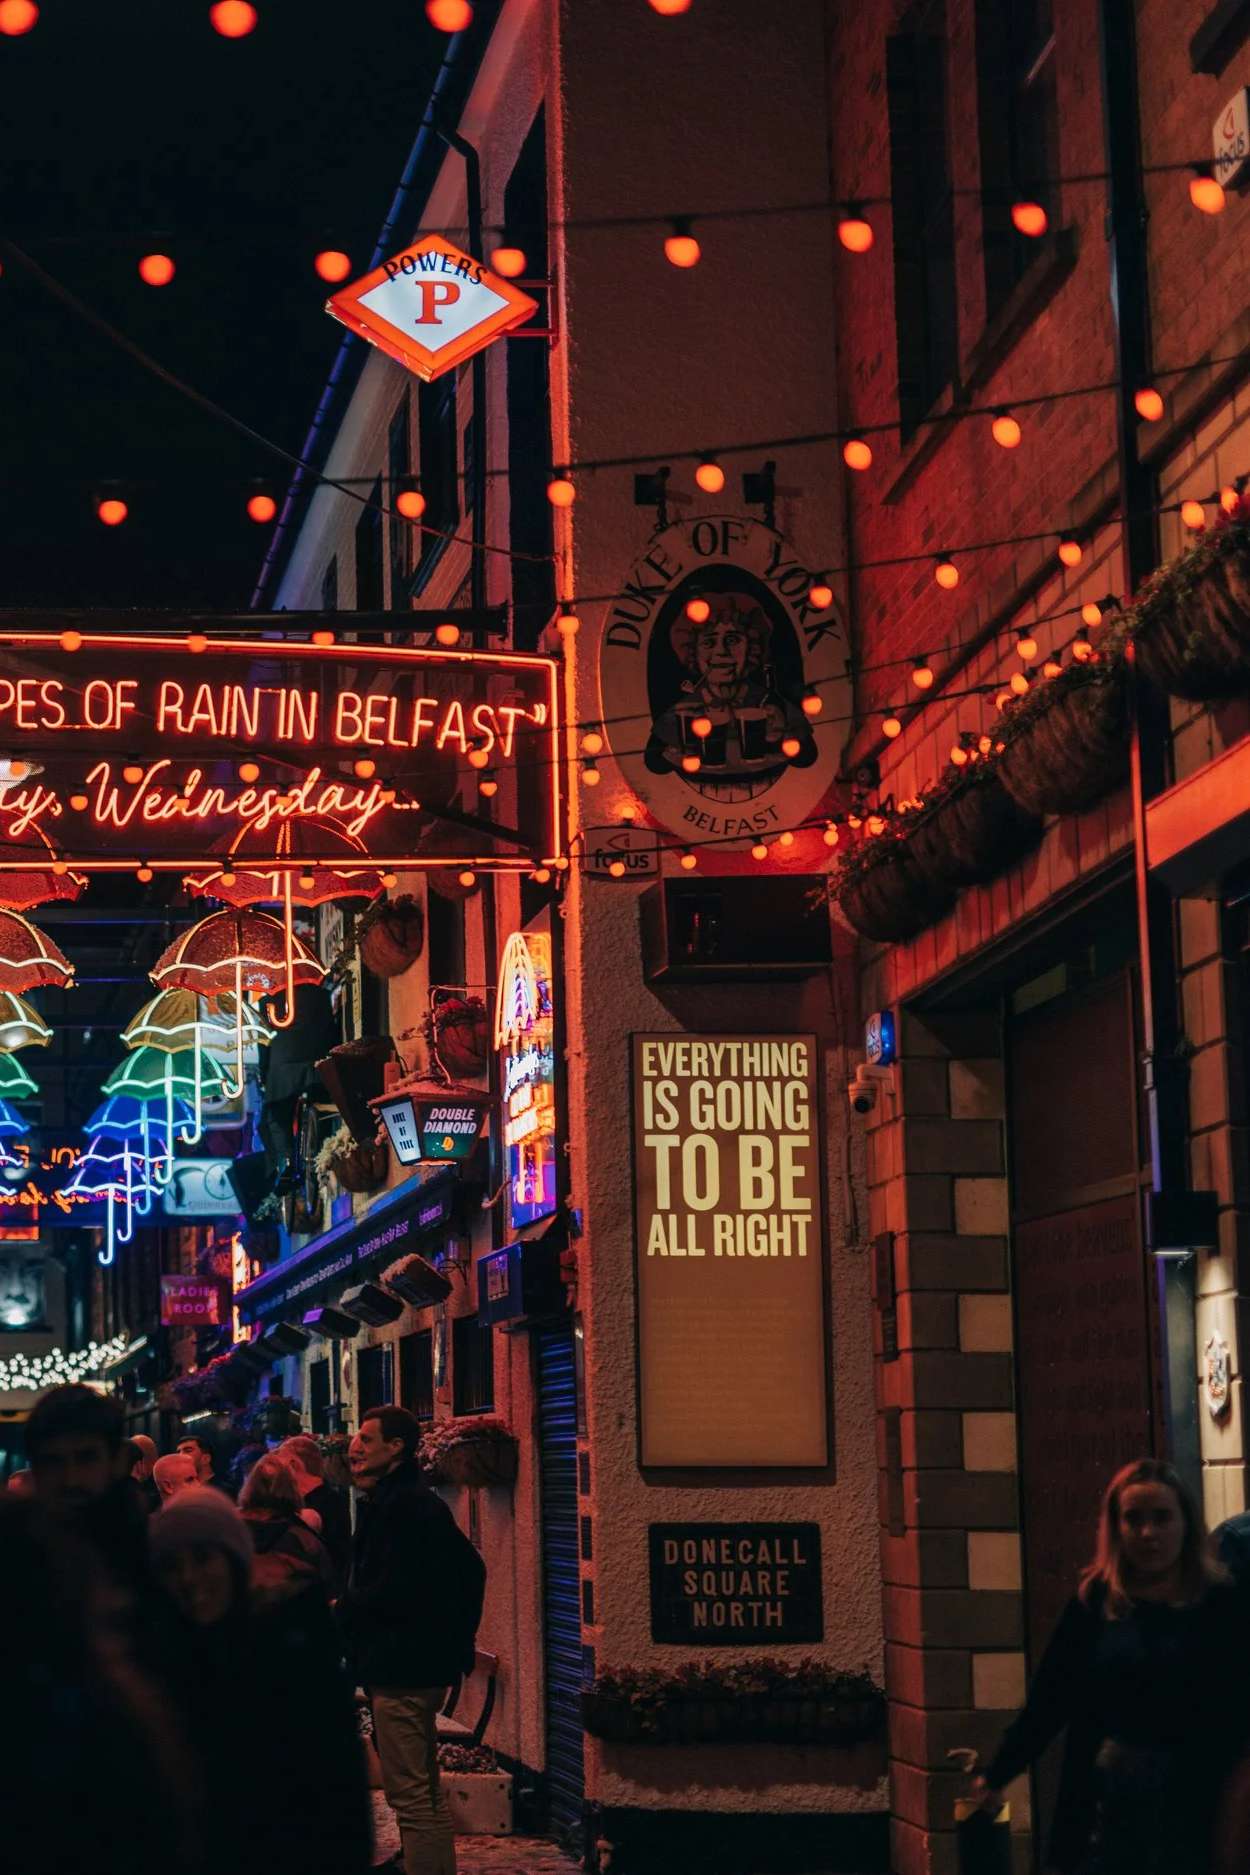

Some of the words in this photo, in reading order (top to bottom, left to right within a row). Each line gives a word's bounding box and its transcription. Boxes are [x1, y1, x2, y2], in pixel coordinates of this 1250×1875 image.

[382, 251, 488, 286] POWERS
[414, 280, 461, 324] P
[606, 543, 683, 651] DUKE
[691, 520, 746, 557] OF
[762, 541, 842, 653] YORK
[83, 679, 138, 730] OF
[156, 680, 261, 738] RAIN
[277, 687, 318, 741] IN
[681, 803, 780, 838] BELFAST
[594, 847, 650, 869] fous
[642, 1042, 808, 1077] EVERYTHING
[430, 1108, 476, 1121] DOUBLE
[643, 1080, 680, 1131] IS
[689, 1080, 810, 1131] GOING
[423, 1121, 477, 1134] DIAMOND
[644, 1133, 720, 1211] TO
[738, 1134, 812, 1210] BE
[647, 1214, 706, 1257] ALL
[713, 1213, 812, 1257] RIGHT
[683, 1569, 791, 1597] SQUARE
[693, 1601, 783, 1627] NORTH
